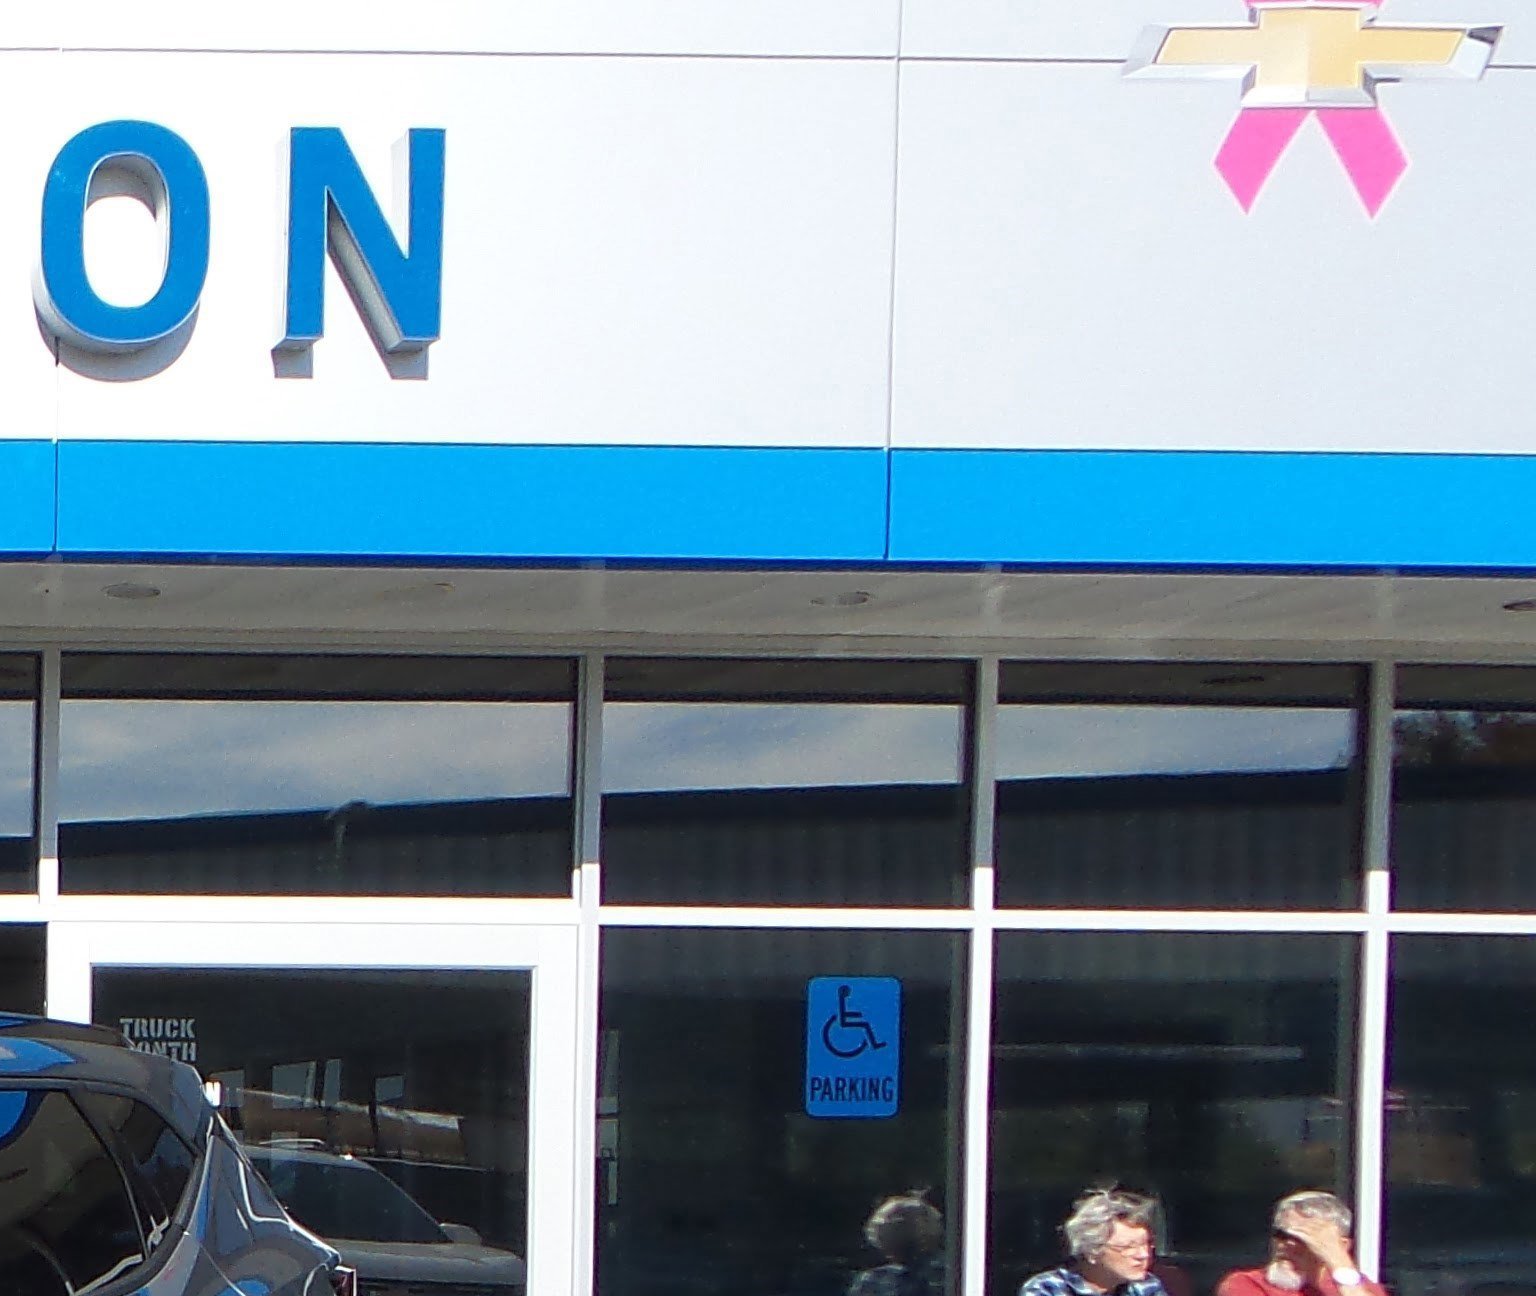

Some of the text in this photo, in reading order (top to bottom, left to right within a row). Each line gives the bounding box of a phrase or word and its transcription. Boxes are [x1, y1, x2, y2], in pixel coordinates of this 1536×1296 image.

[119, 1017, 196, 1039] TRUCK
[130, 1040, 197, 1062] ONTH
[809, 1075, 895, 1102] PARKING
